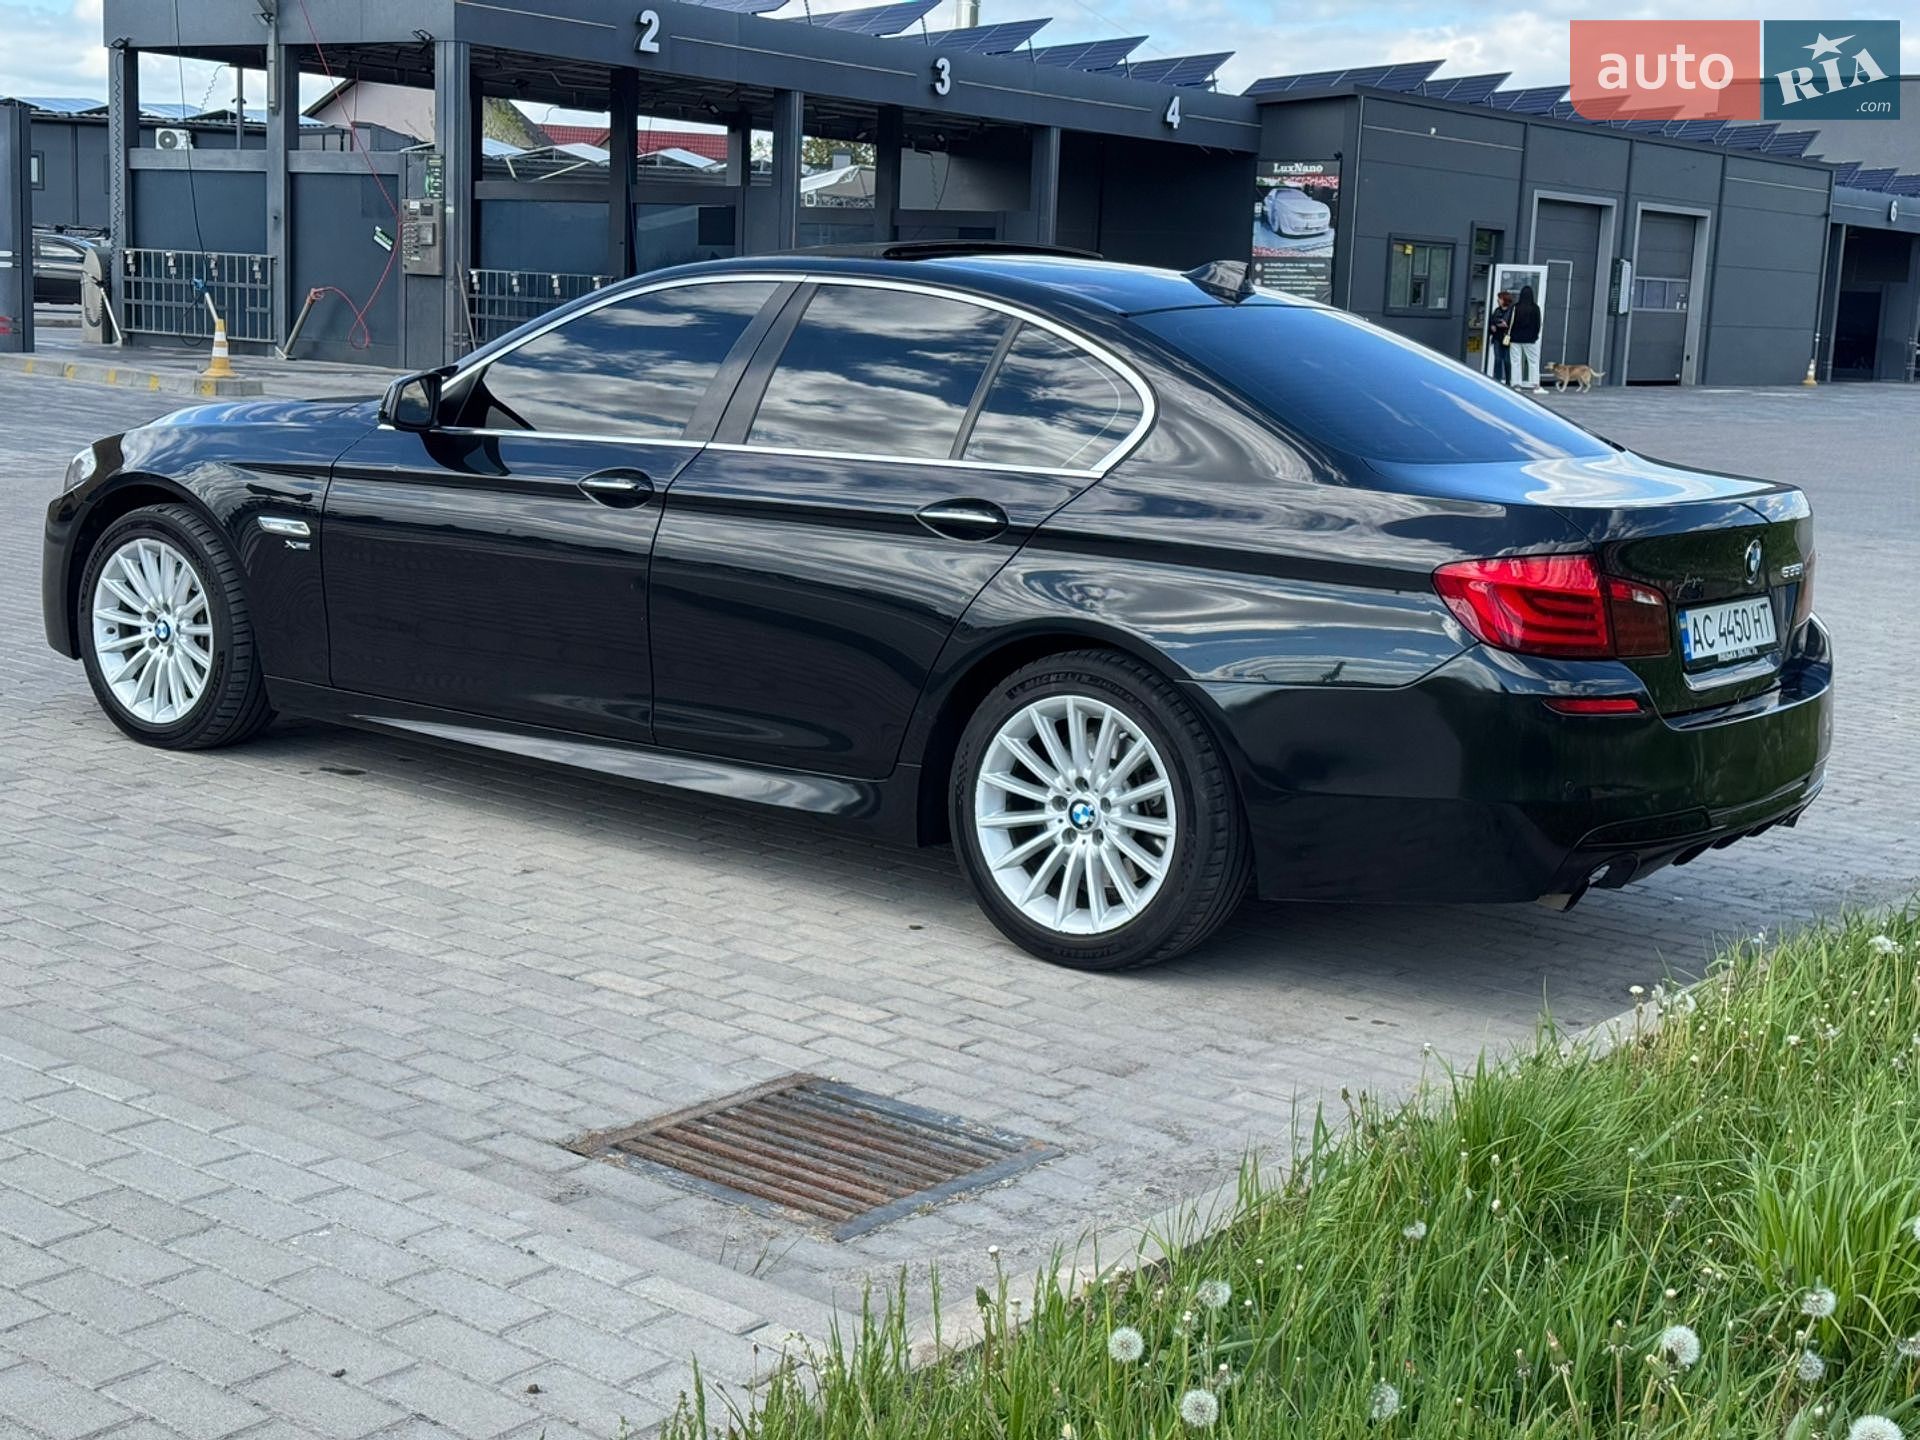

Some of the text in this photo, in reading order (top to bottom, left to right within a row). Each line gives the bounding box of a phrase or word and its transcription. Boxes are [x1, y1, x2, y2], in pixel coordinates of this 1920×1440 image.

[637, 9, 660, 53] 2
[934, 57, 951, 96] 3
[1166, 95, 1181, 129] 4
[1273, 162, 1324, 173] LuxNano
[1890, 200, 1898, 222] 6
[1693, 603, 1771, 652] AC 4450 HT
